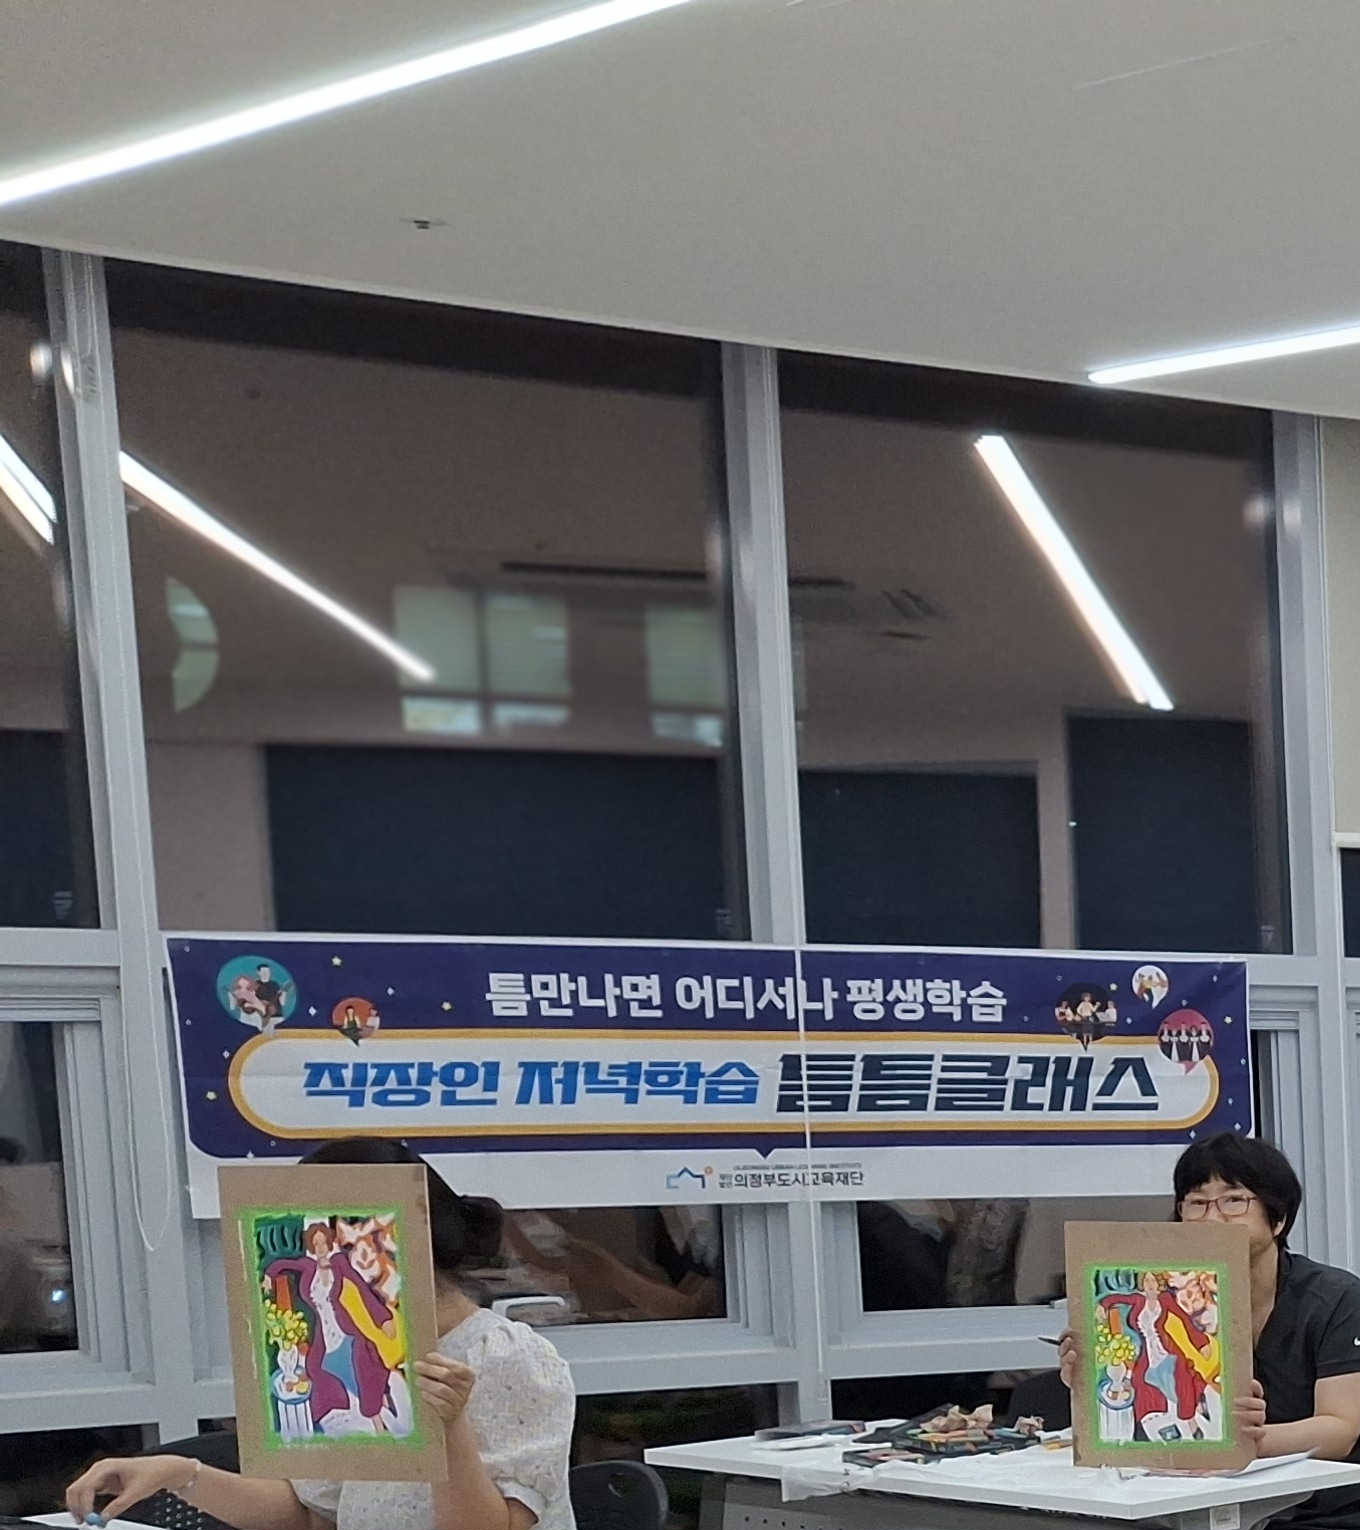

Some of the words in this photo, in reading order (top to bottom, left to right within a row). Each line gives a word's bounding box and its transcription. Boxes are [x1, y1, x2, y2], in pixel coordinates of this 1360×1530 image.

[485, 971, 663, 1019] 틈만나면
[675, 974, 840, 1021] 어디서나
[845, 977, 1008, 1023] 평생학습
[303, 1060, 501, 1108] 직장인
[515, 1060, 761, 1106] 저녁학습
[776, 1052, 1160, 1113] 틈틈클래스
[733, 1171, 864, 1188] 의정부도시교육재단
